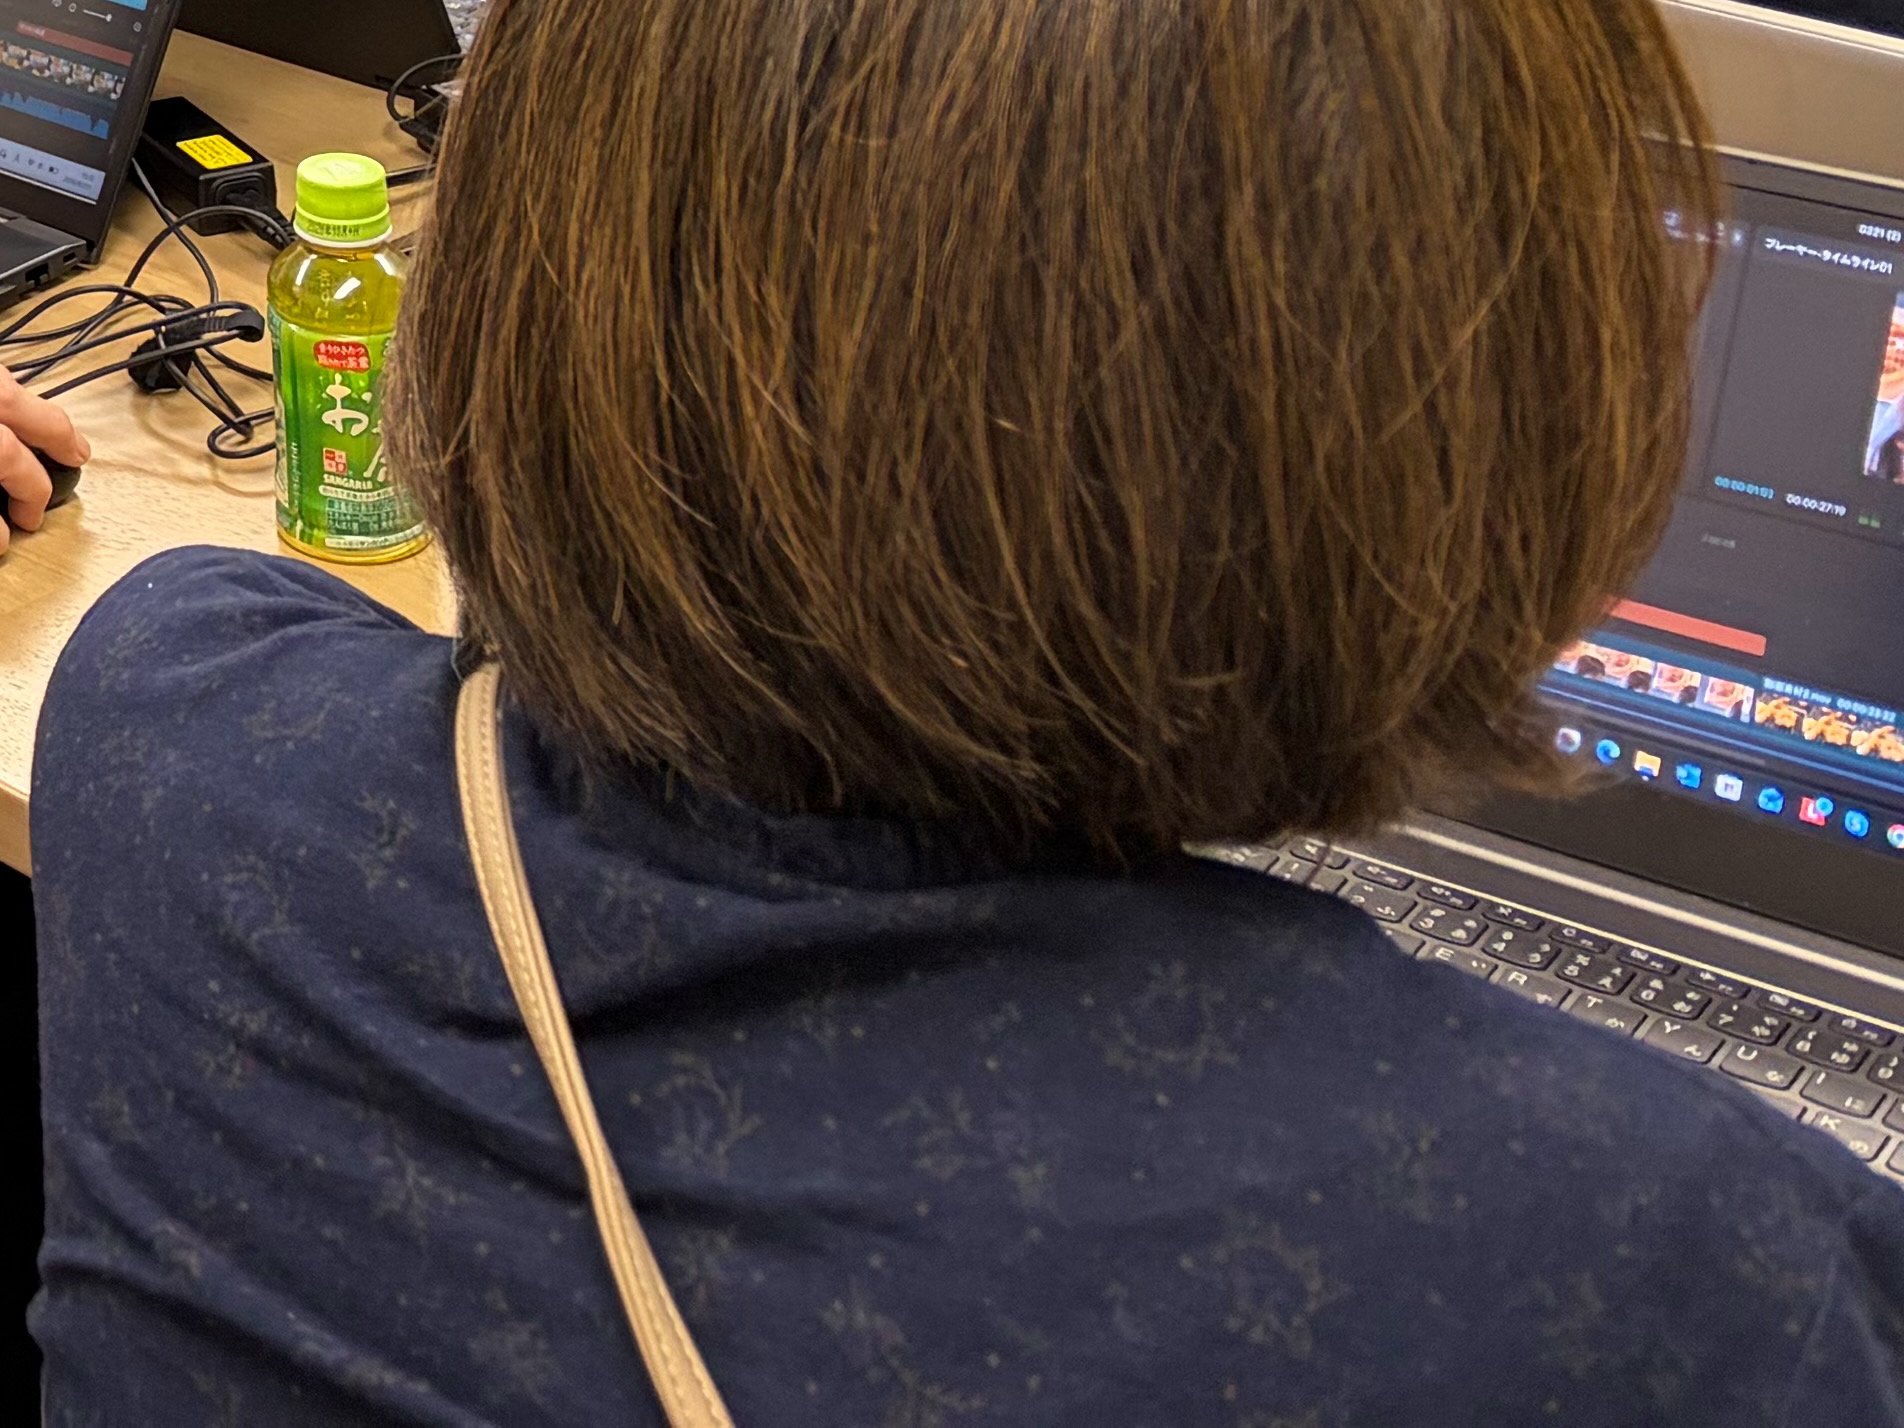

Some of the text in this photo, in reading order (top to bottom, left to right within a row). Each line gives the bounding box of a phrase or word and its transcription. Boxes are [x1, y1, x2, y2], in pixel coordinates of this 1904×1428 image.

[1435, 947, 1455, 961] E
[1507, 971, 1528, 986] R
[1586, 994, 1603, 1008] T
[1664, 1020, 1681, 1034] Y
[1736, 1044, 1758, 1061] U
[1819, 1113, 1842, 1131] K
